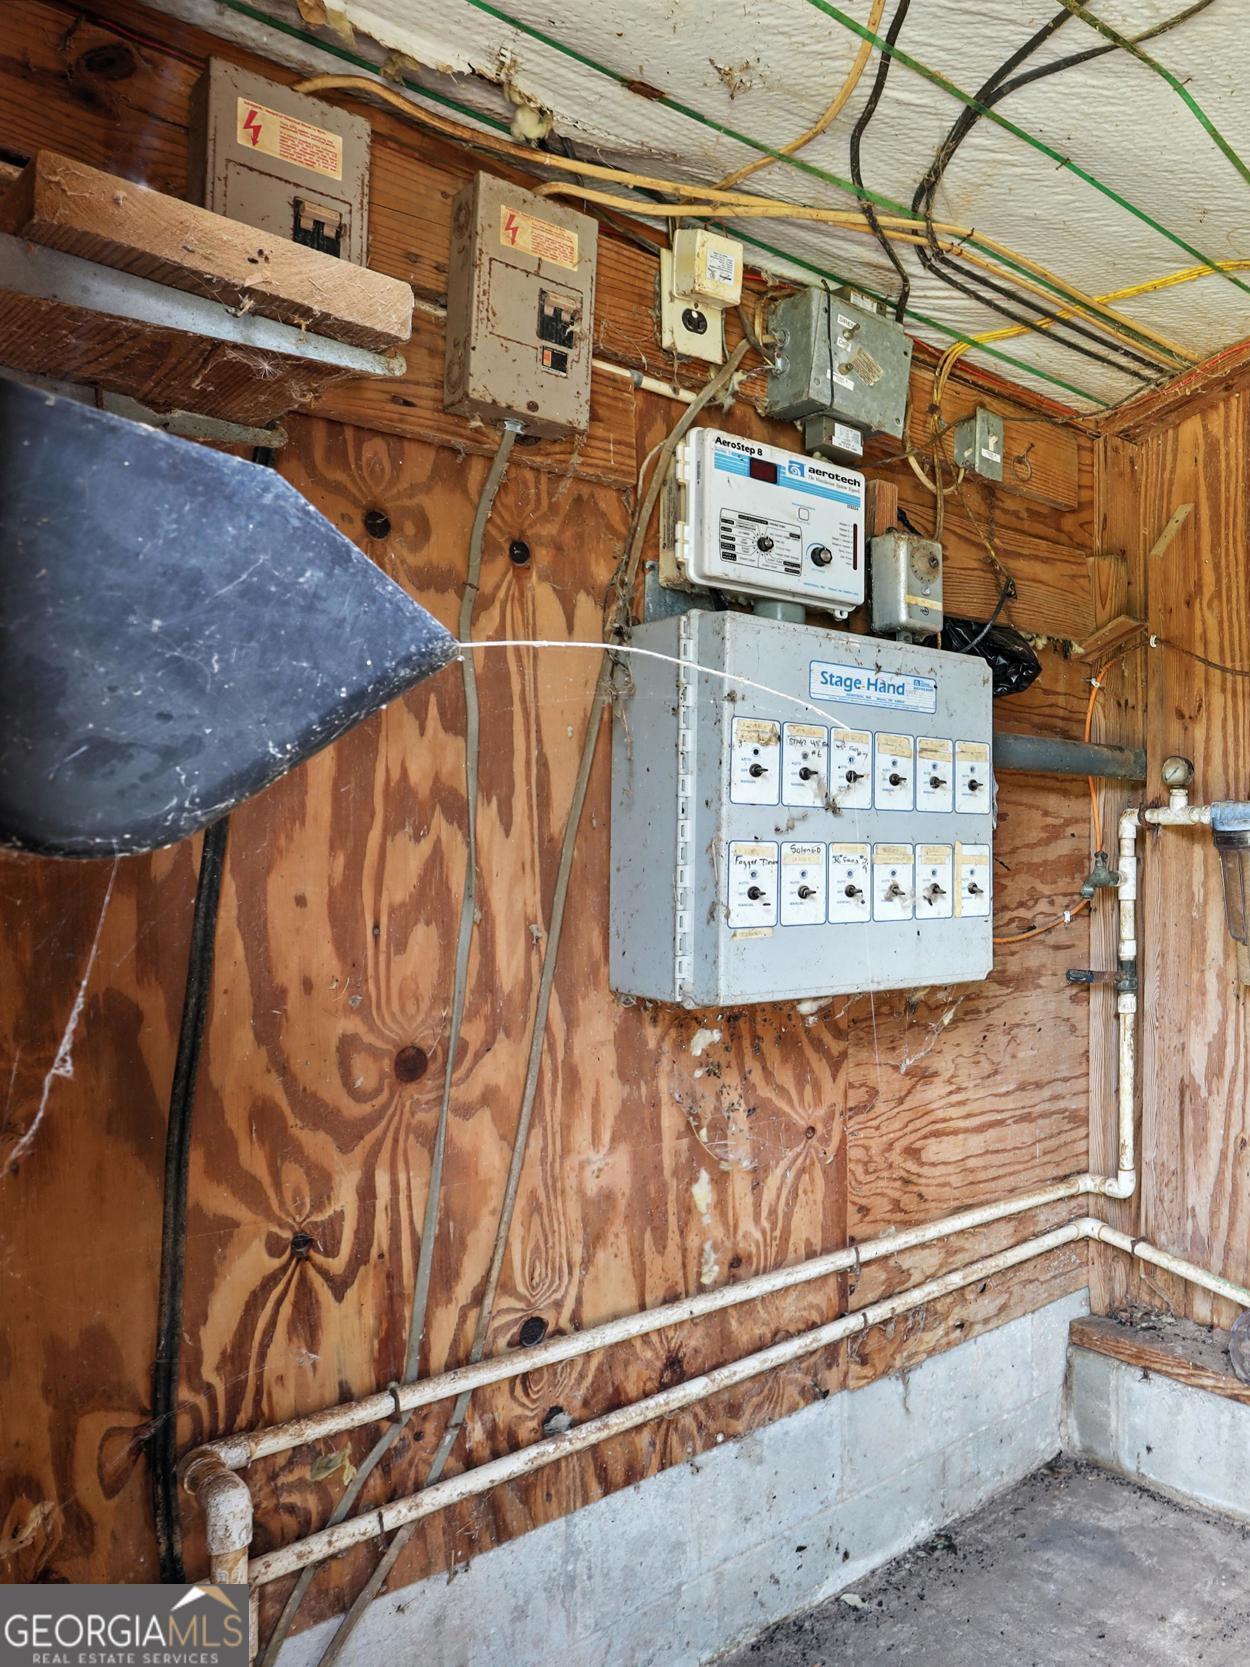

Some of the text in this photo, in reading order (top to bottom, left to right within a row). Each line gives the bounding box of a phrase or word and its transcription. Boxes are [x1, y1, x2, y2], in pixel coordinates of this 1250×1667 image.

[715, 436, 764, 456] AeroStep 8
[808, 466, 861, 488] aerotech
[820, 670, 905, 696] Stage Hand
